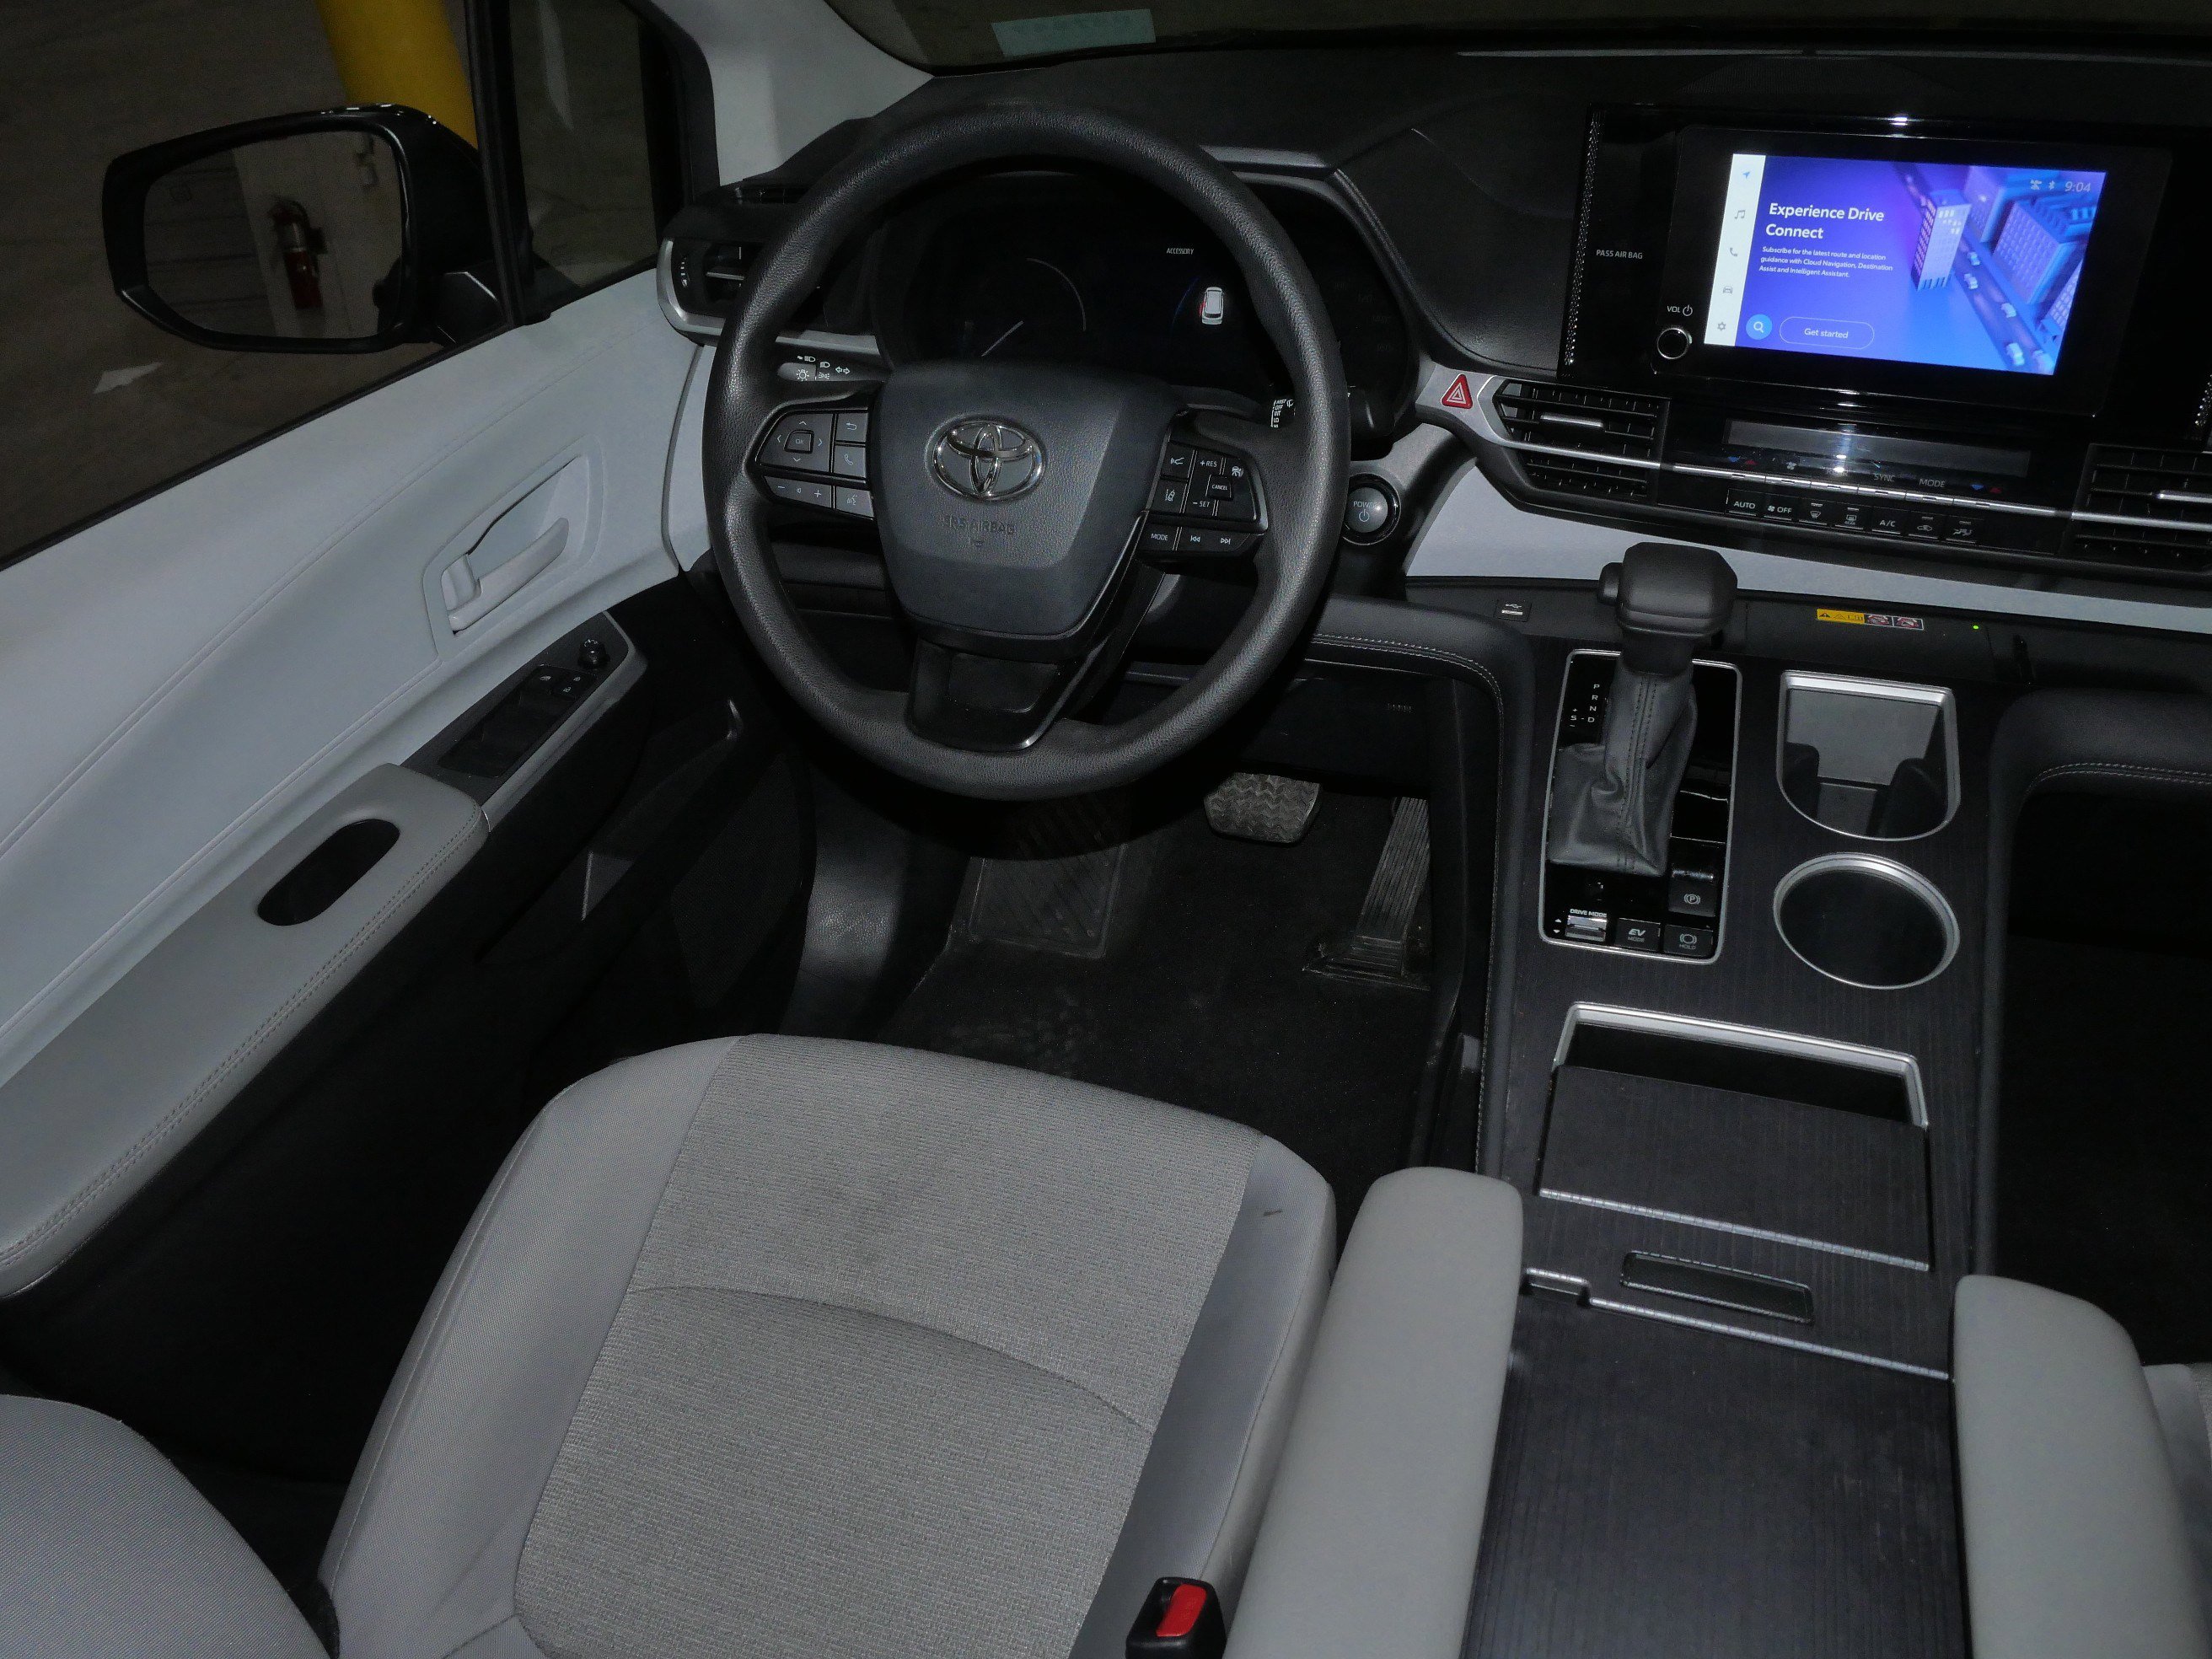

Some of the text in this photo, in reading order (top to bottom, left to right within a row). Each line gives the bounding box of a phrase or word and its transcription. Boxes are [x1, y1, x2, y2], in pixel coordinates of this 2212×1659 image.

[2064, 180, 2091, 192] 9:04
[1769, 202, 1885, 222] Experience Drive
[1765, 223, 1823, 239] Connect
[1596, 249, 1643, 260] PASS AIR BAG
[1762, 245, 1791, 255] Subscribe
[1812, 249, 1830, 257] latest
[1861, 252, 1887, 260] location
[1760, 255, 1788, 265] guidance
[1802, 258, 1822, 266] Cloud
[1823, 260, 1857, 269] Navigation,
[1857, 262, 1893, 271] Destination
[1790, 267, 1821, 276] Intelligent
[1821, 270, 1850, 278] Assistant.
[1804, 327, 1849, 339] Get started
[1873, 473, 1896, 483] SYNC
[1918, 478, 1946, 488] MODE
[1733, 501, 1756, 510] AUTO
[1879, 519, 1896, 528] A/C
[1151, 533, 1168, 541] MODE
[1628, 928, 1646, 937] EV
